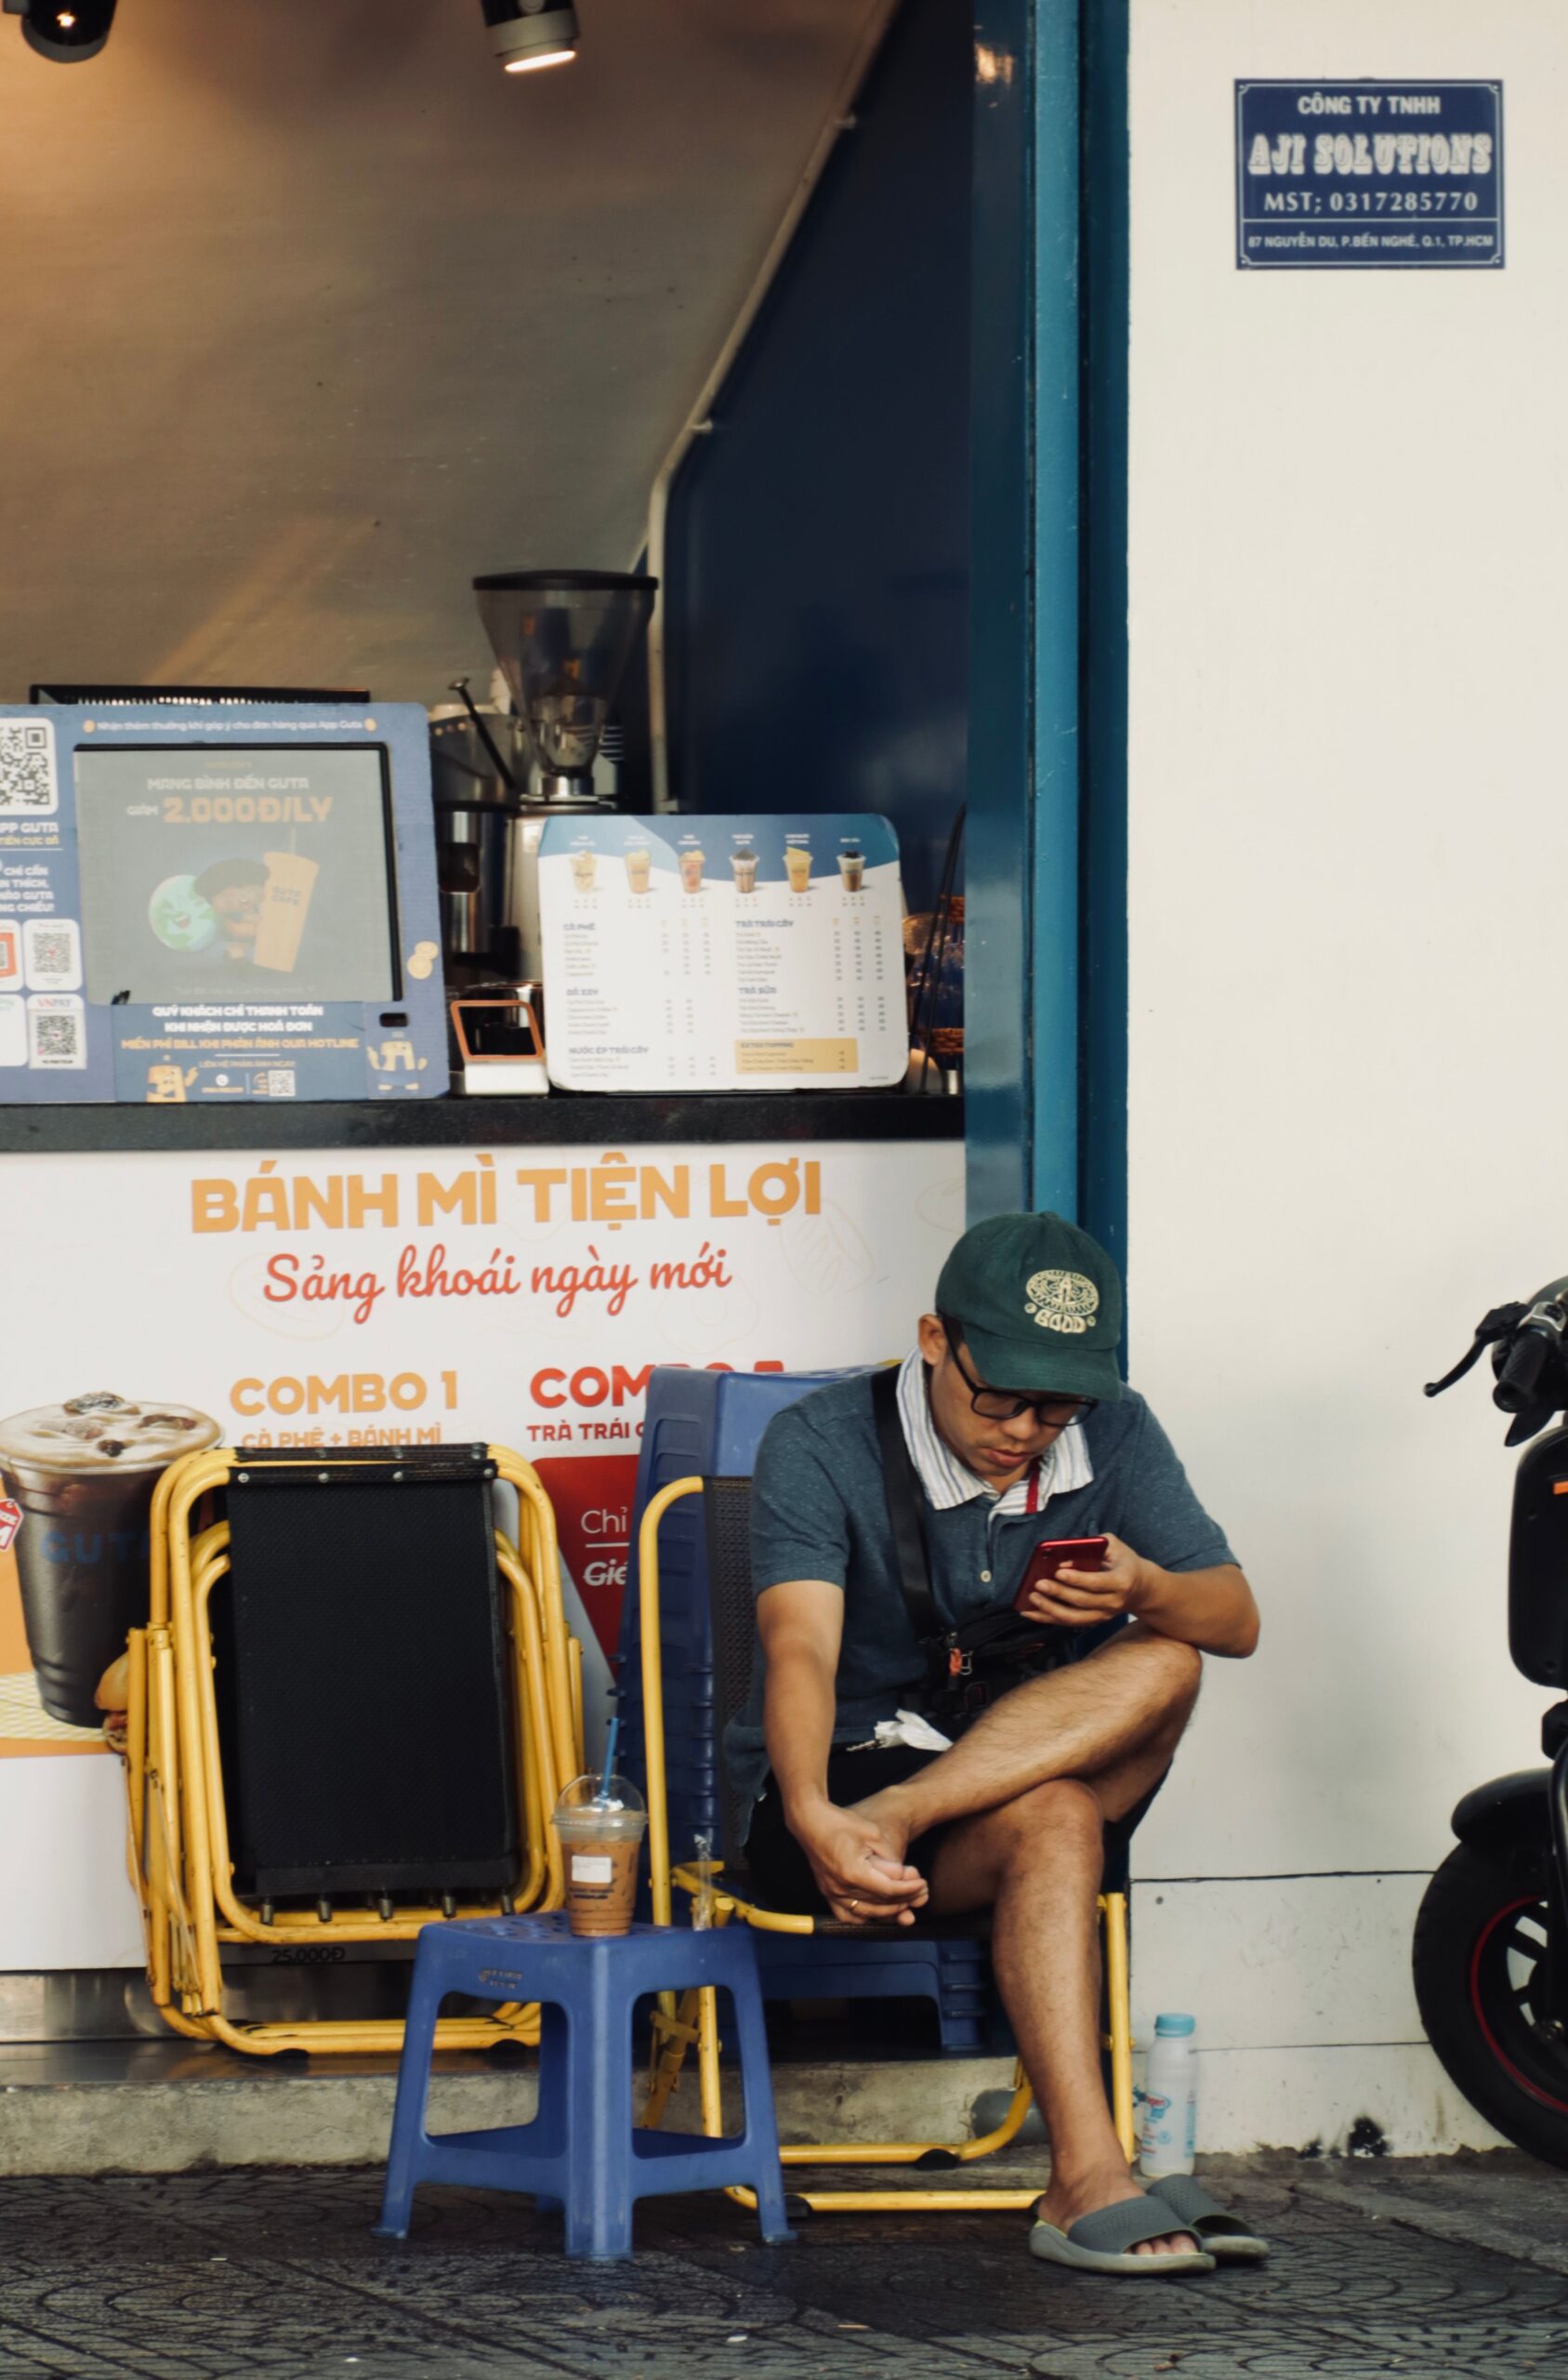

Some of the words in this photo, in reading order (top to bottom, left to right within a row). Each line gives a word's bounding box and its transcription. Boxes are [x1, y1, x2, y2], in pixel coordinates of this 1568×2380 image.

[1298, 92, 1351, 114] CÔNG
[1356, 96, 1382, 114] TY
[1387, 96, 1441, 114] TNHH
[1248, 133, 1306, 175] AJI
[1313, 133, 1492, 175] SOLUTIONS
[1329, 192, 1478, 211] 0317285770
[1265, 231, 1315, 247] NGUYỄN
[1447, 235, 1494, 246] TP.HCM
[147, 777, 192, 789] MANG
[194, 774, 231, 789] BÌNH
[233, 774, 265, 789] ĐẾN
[267, 777, 310, 789] GUTA
[20, 822, 59, 833] GUTA
[180, 1004, 222, 1016] KHÁCH
[245, 1006, 288, 1016] THANH
[289, 1003, 323, 1016] TOÁN
[165, 1022, 187, 1032] KHI
[188, 1020, 221, 1033] NHẬN
[173, 1039, 199, 1049] BILL
[281, 1038, 306, 1049] QUA
[307, 1038, 359, 1049] HOTLINE
[191, 1159, 398, 1233] BÁNH
[416, 1154, 496, 1225] MÌ
[517, 1151, 690, 1231] TIỆN
[708, 1157, 821, 1225] LỢI
[263, 1252, 385, 1325] Sảng
[397, 1243, 520, 1299] khoái
[530, 1245, 638, 1318] ngày
[649, 1241, 732, 1289] mới
[230, 1371, 428, 1417] COMBO
[441, 1370, 458, 1408] 1
[242, 1428, 271, 1448] CÀ
[279, 1427, 323, 1448] PHÊ
[348, 1424, 411, 1447] BÁNH
[416, 1422, 441, 1446] MÌ
[527, 1419, 573, 1441] TRÀ
[578, 1418, 630, 1440] TRÁI
[581, 1506, 627, 1534] Chỉ
